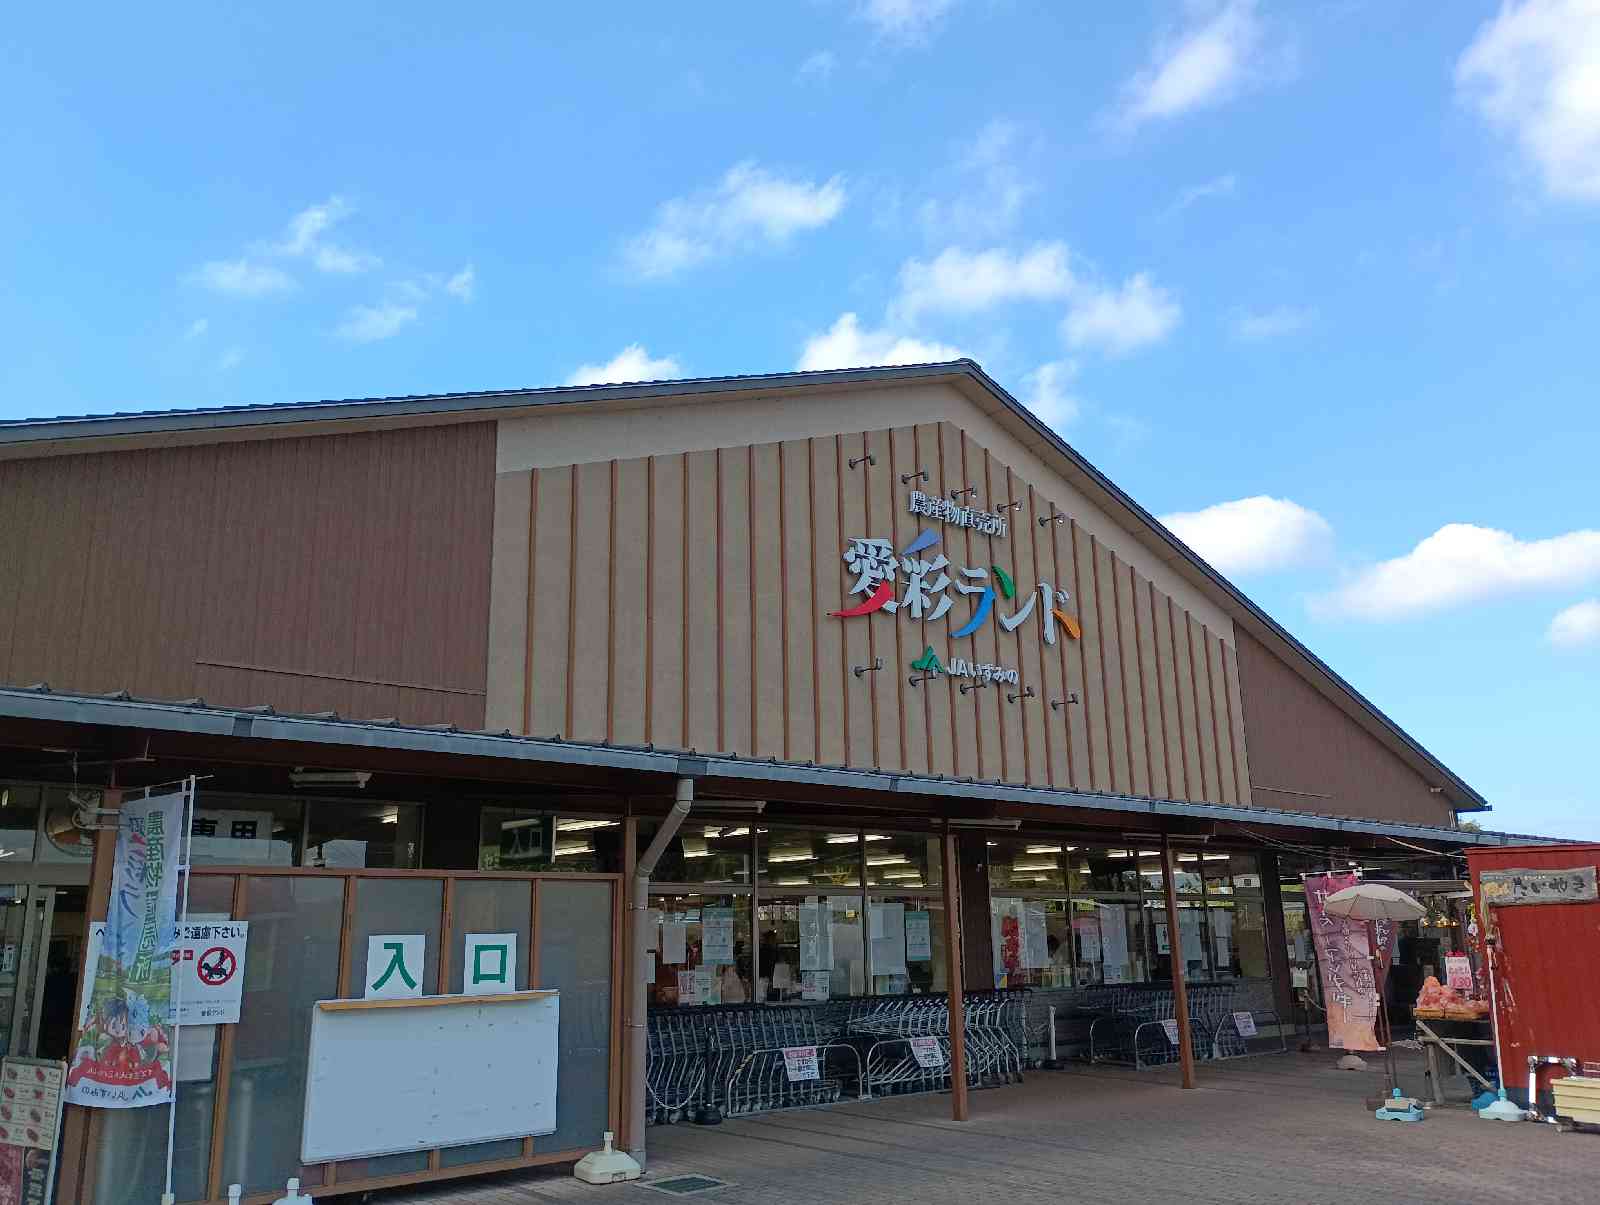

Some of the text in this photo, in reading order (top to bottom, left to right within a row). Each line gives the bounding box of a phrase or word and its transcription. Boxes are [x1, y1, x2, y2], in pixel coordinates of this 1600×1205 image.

[908, 490, 1008, 538] 農産物直売所
[826, 527, 1081, 645] 愛彩ランド
[371, 943, 508, 991] 入口
